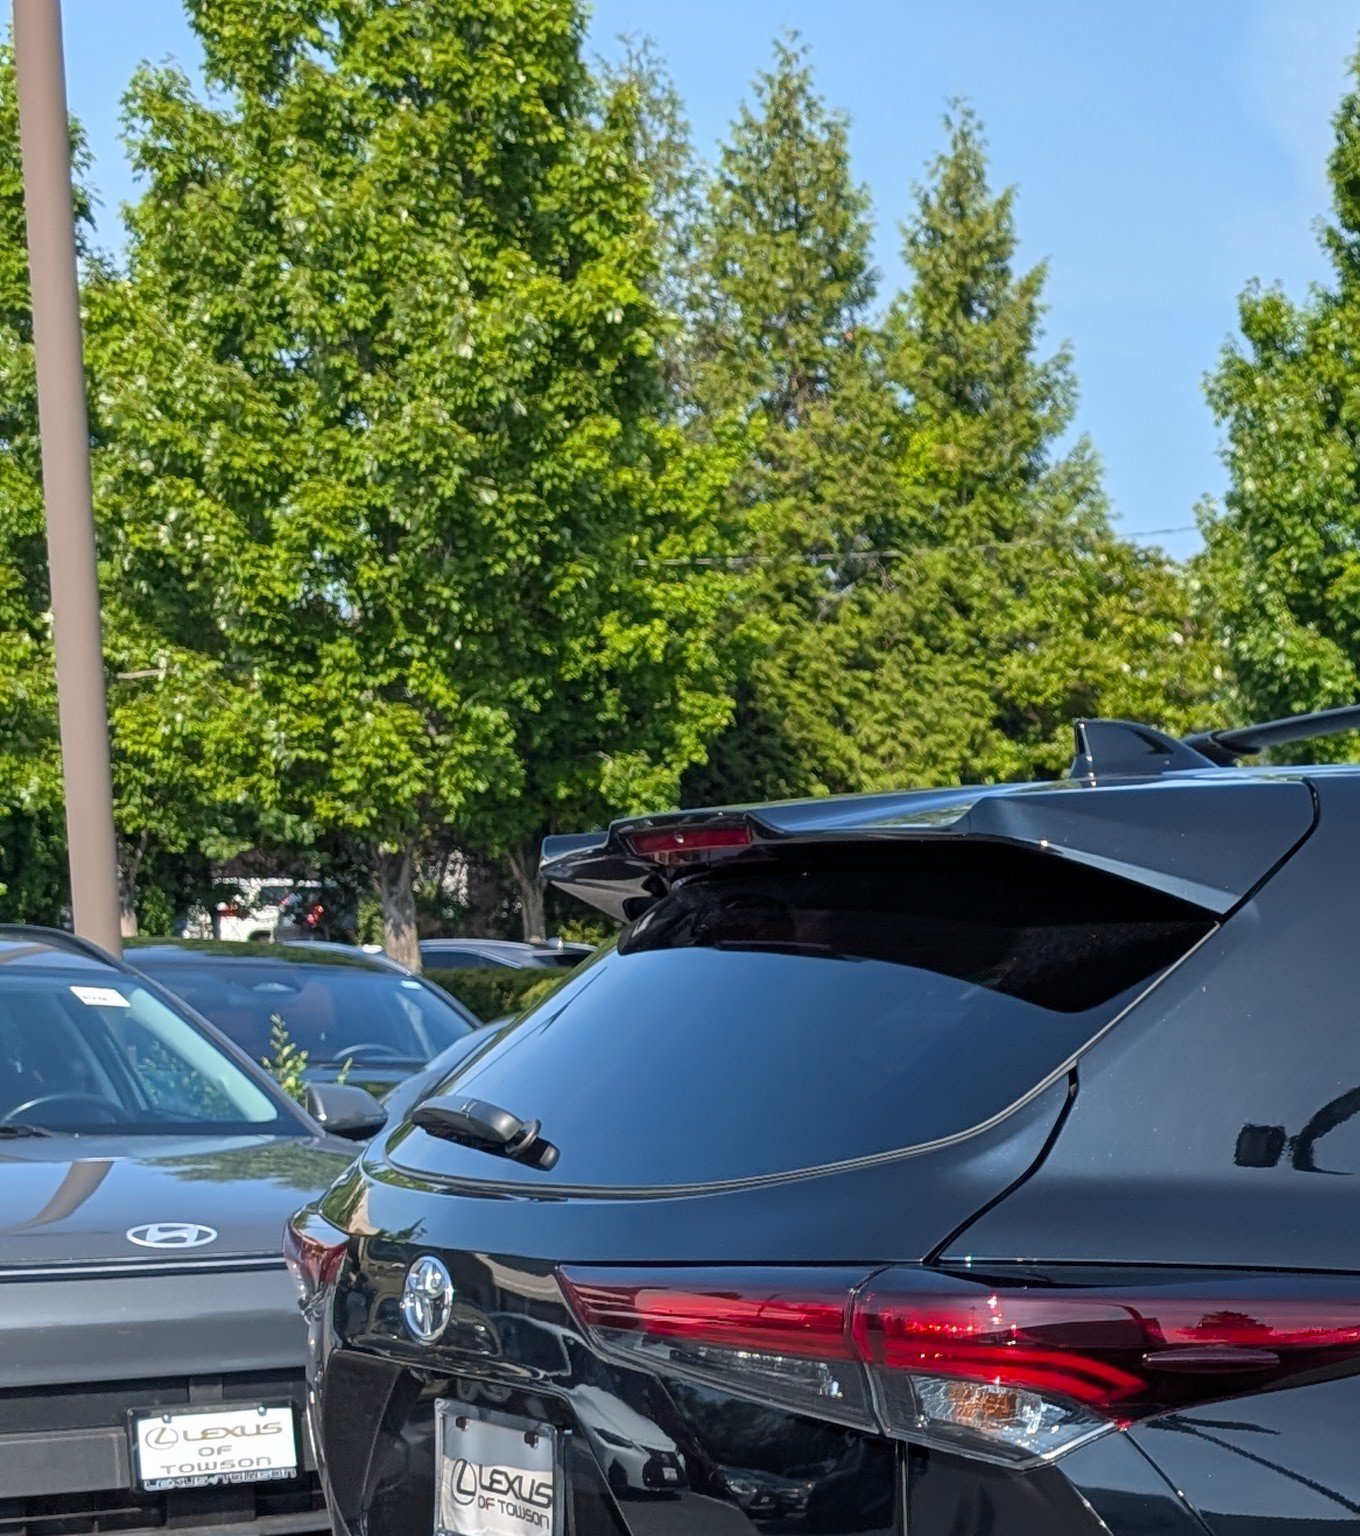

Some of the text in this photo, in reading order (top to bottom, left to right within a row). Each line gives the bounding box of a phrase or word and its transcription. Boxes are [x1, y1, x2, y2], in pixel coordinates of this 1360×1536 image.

[182, 1421, 284, 1442] LEXUS
[197, 1444, 233, 1457] OF
[160, 1456, 272, 1475] TOWSON
[478, 1463, 554, 1510] LEXUS
[477, 1494, 550, 1530] OF TOWSON
